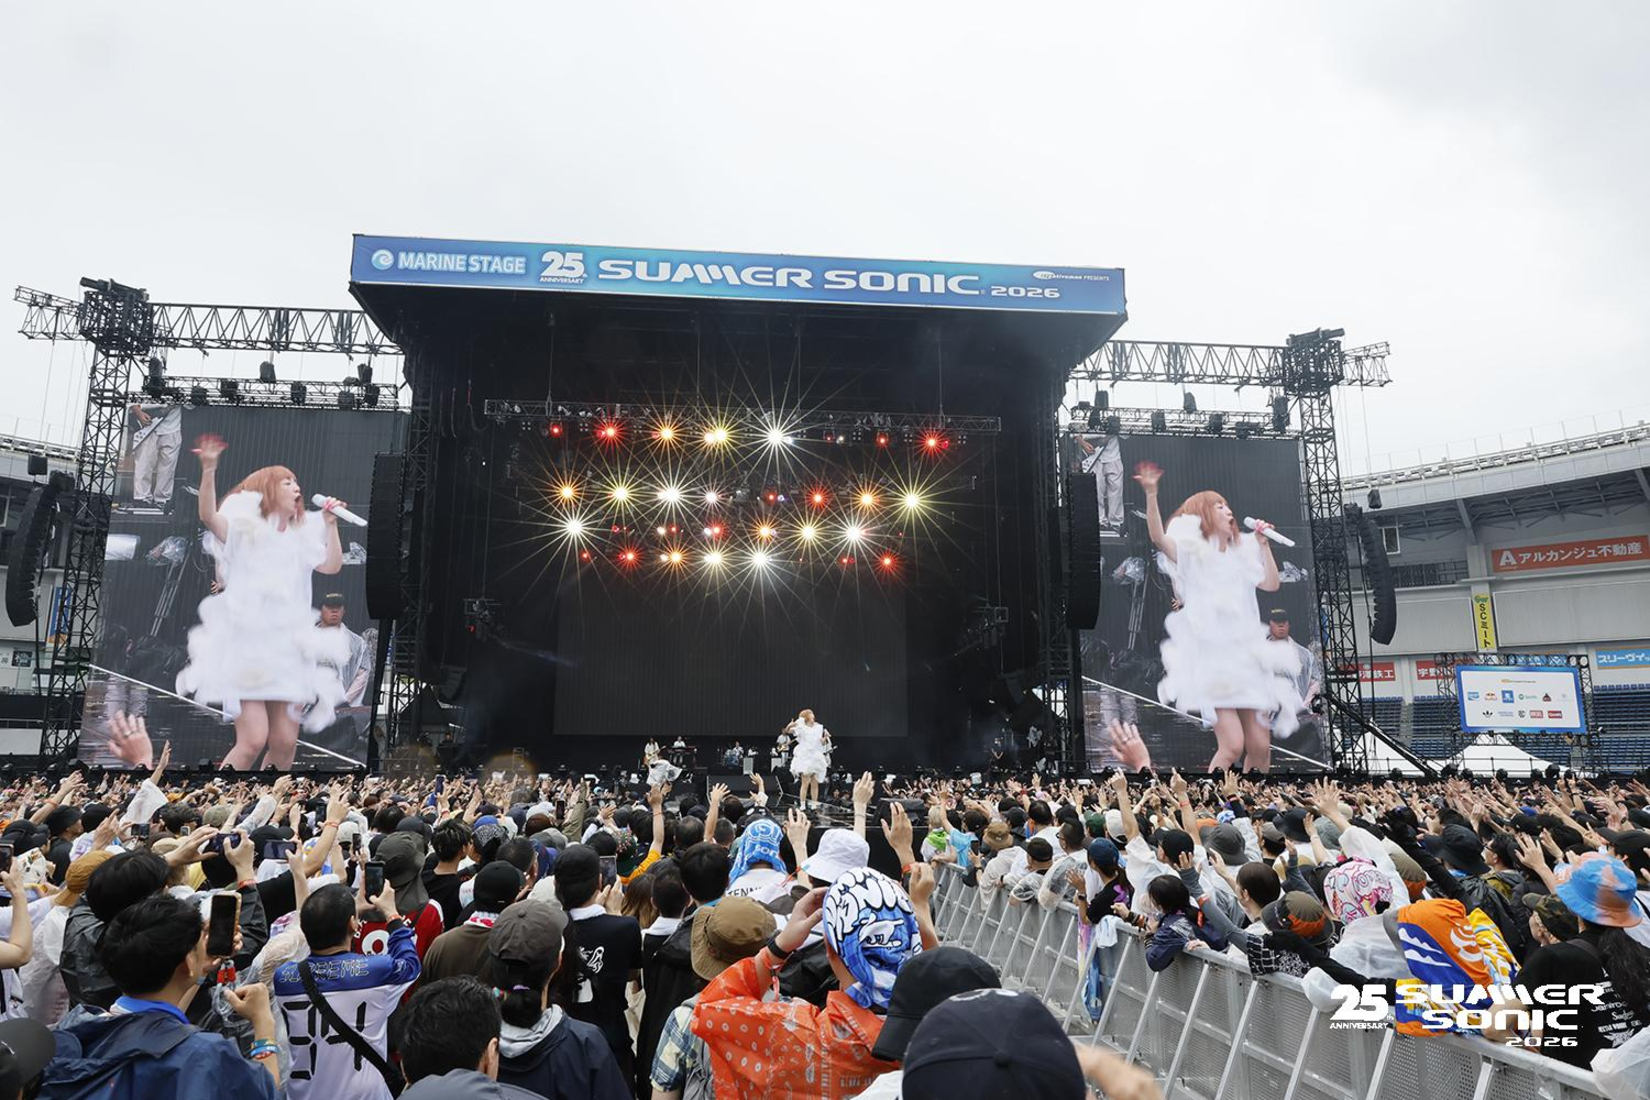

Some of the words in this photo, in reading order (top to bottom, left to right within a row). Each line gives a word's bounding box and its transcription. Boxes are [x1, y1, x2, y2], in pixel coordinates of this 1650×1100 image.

[398, 251, 466, 271] MARINE
[468, 254, 526, 273] STAGE
[598, 259, 814, 289] SUMMER
[824, 270, 981, 296] SONIC
[991, 285, 1061, 298] 2026
[1519, 542, 1643, 564] アルカンジュ不動産
